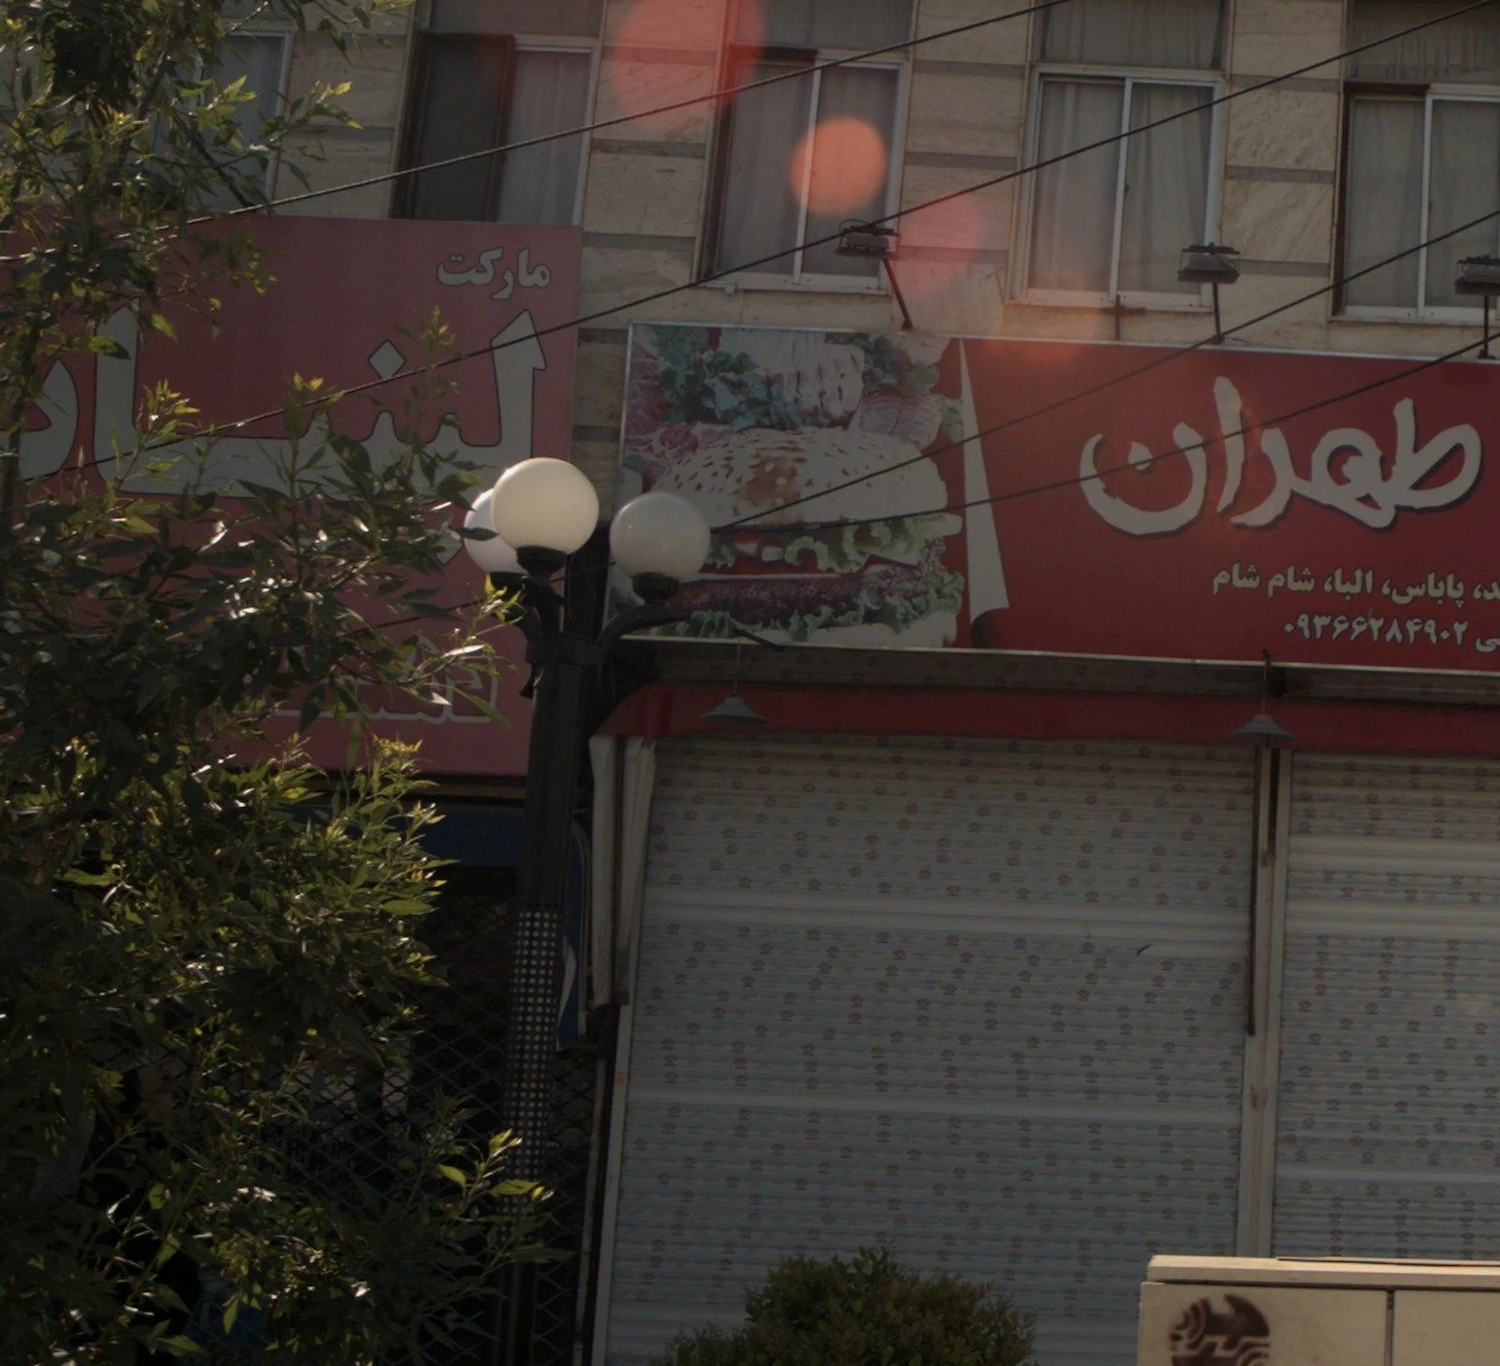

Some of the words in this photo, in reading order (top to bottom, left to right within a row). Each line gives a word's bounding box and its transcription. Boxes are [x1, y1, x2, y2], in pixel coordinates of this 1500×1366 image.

[436, 245, 551, 300] مارکت
[1079, 375, 1483, 537] طهران
[1211, 561, 1261, 596] شام
[1267, 564, 1316, 599] شام
